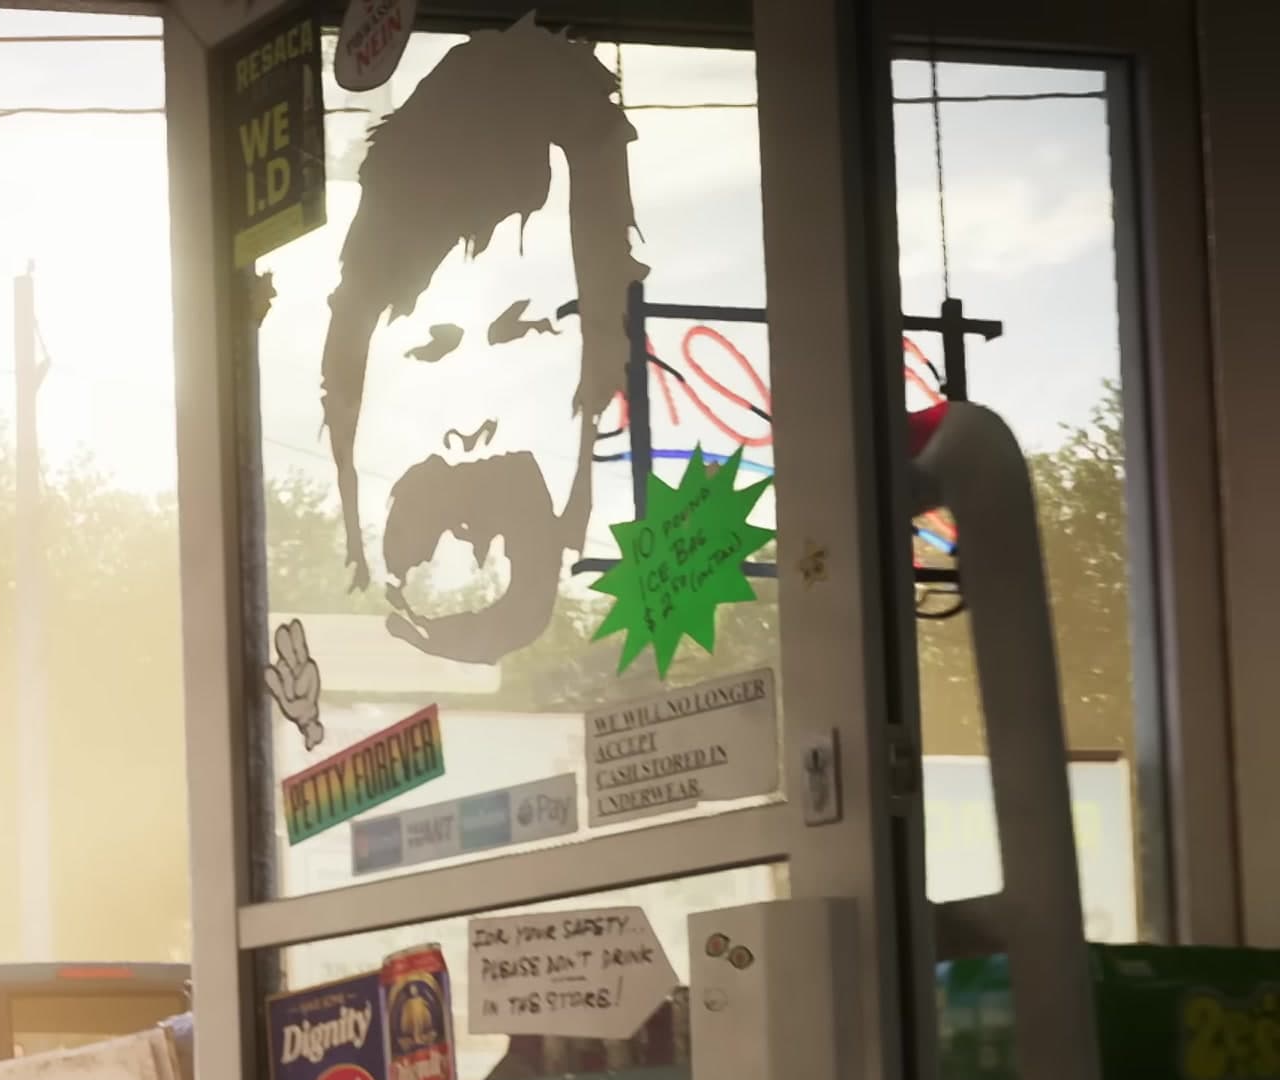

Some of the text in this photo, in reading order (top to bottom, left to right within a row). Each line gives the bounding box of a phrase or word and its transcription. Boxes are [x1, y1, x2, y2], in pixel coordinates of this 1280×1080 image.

[236, 19, 313, 91] RESACA
[240, 102, 290, 164] WE
[632, 527, 655, 566] 10
[639, 560, 670, 602] ICE
[594, 678, 766, 735] WE WILL NO LONGER
[351, 717, 438, 804] FOREVER
[595, 732, 658, 763] ACCEPT
[595, 743, 728, 791] CASH STORED IN
[537, 794, 570, 827] Pay
[472, 927, 508, 950] FOR
[516, 924, 556, 947] YOUR
[481, 955, 540, 983] PLEASE
[602, 942, 654, 969] DRINK
[482, 998, 499, 1015] IN
[508, 992, 541, 1015] THE
[280, 999, 372, 1065] Dignity
